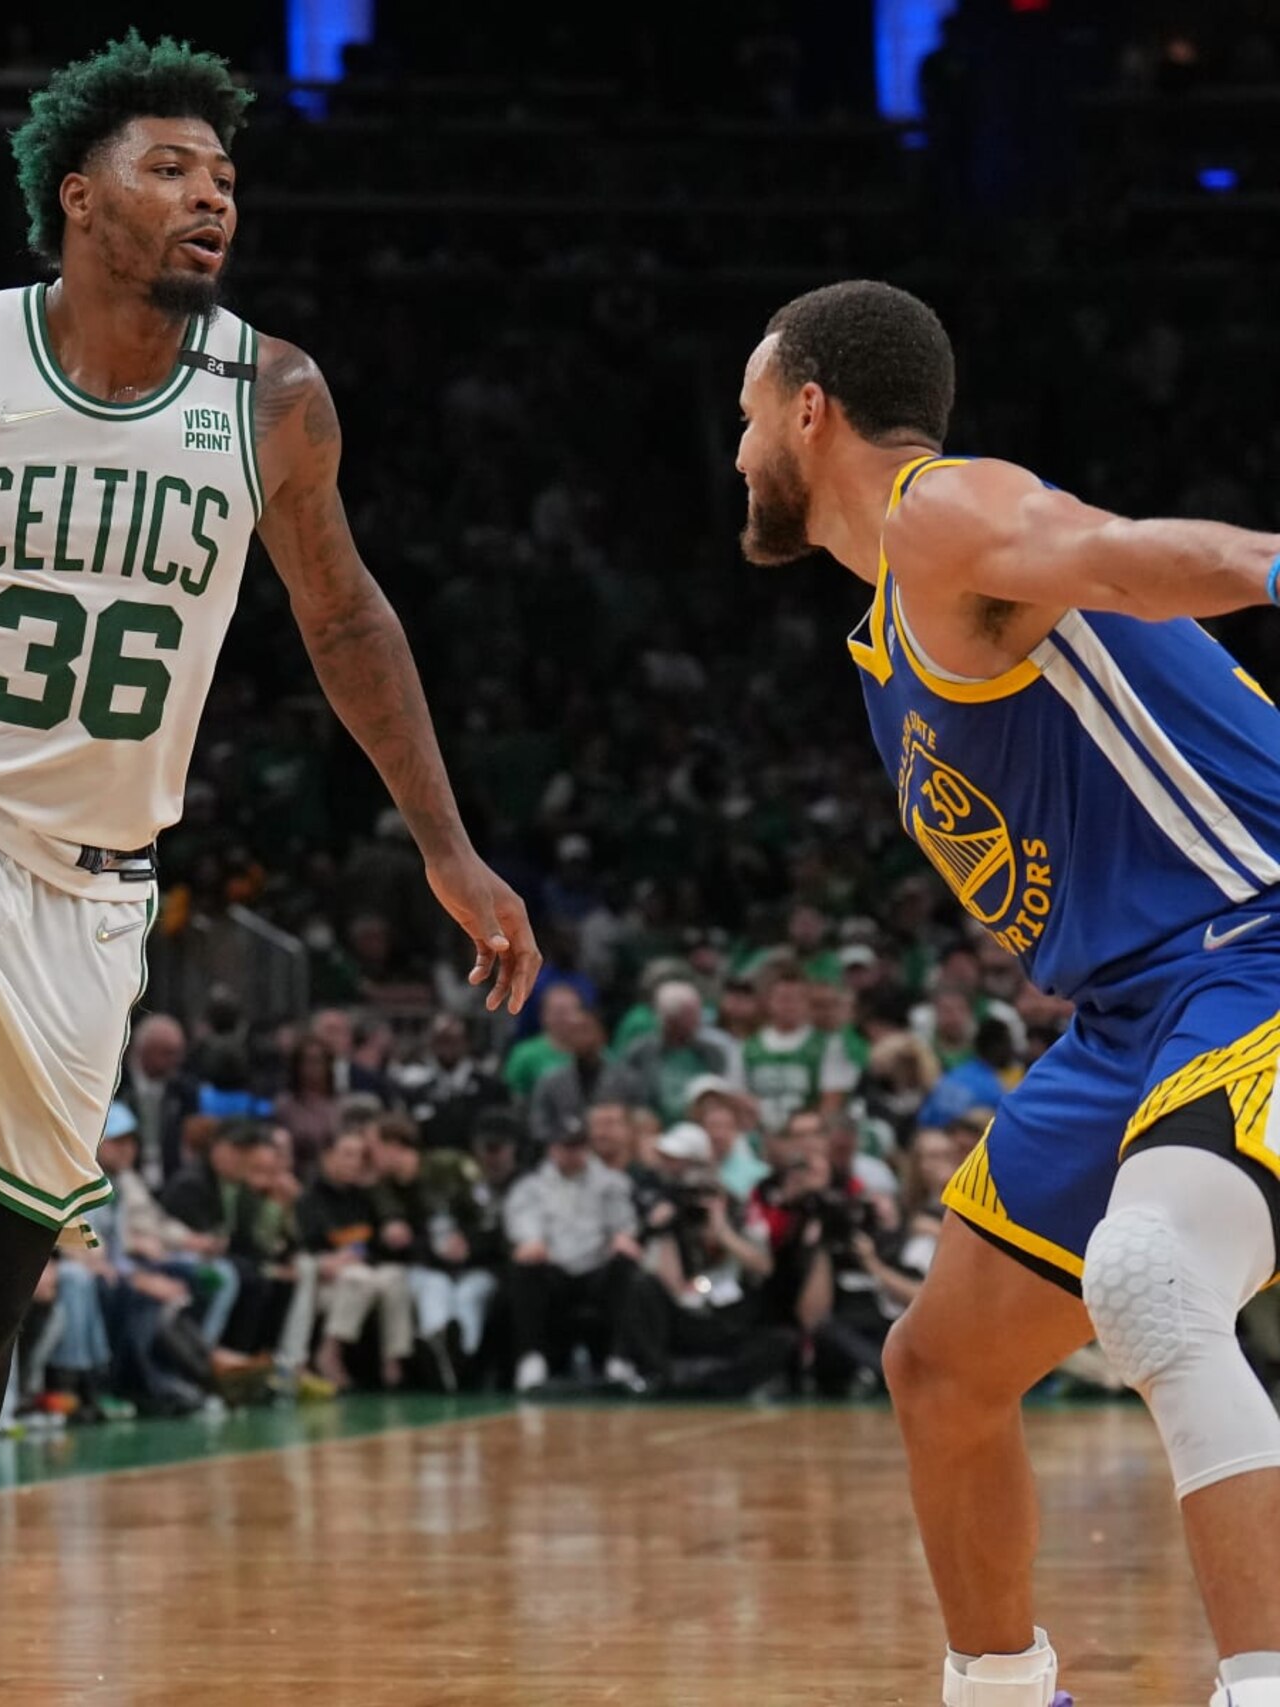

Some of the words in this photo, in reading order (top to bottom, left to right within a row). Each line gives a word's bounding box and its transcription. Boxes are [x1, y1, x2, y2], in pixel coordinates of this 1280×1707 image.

[207, 358, 225, 375] 24
[184, 409, 231, 434] VISTA
[185, 432, 232, 452] PRINT
[921, 769, 971, 832] 30
